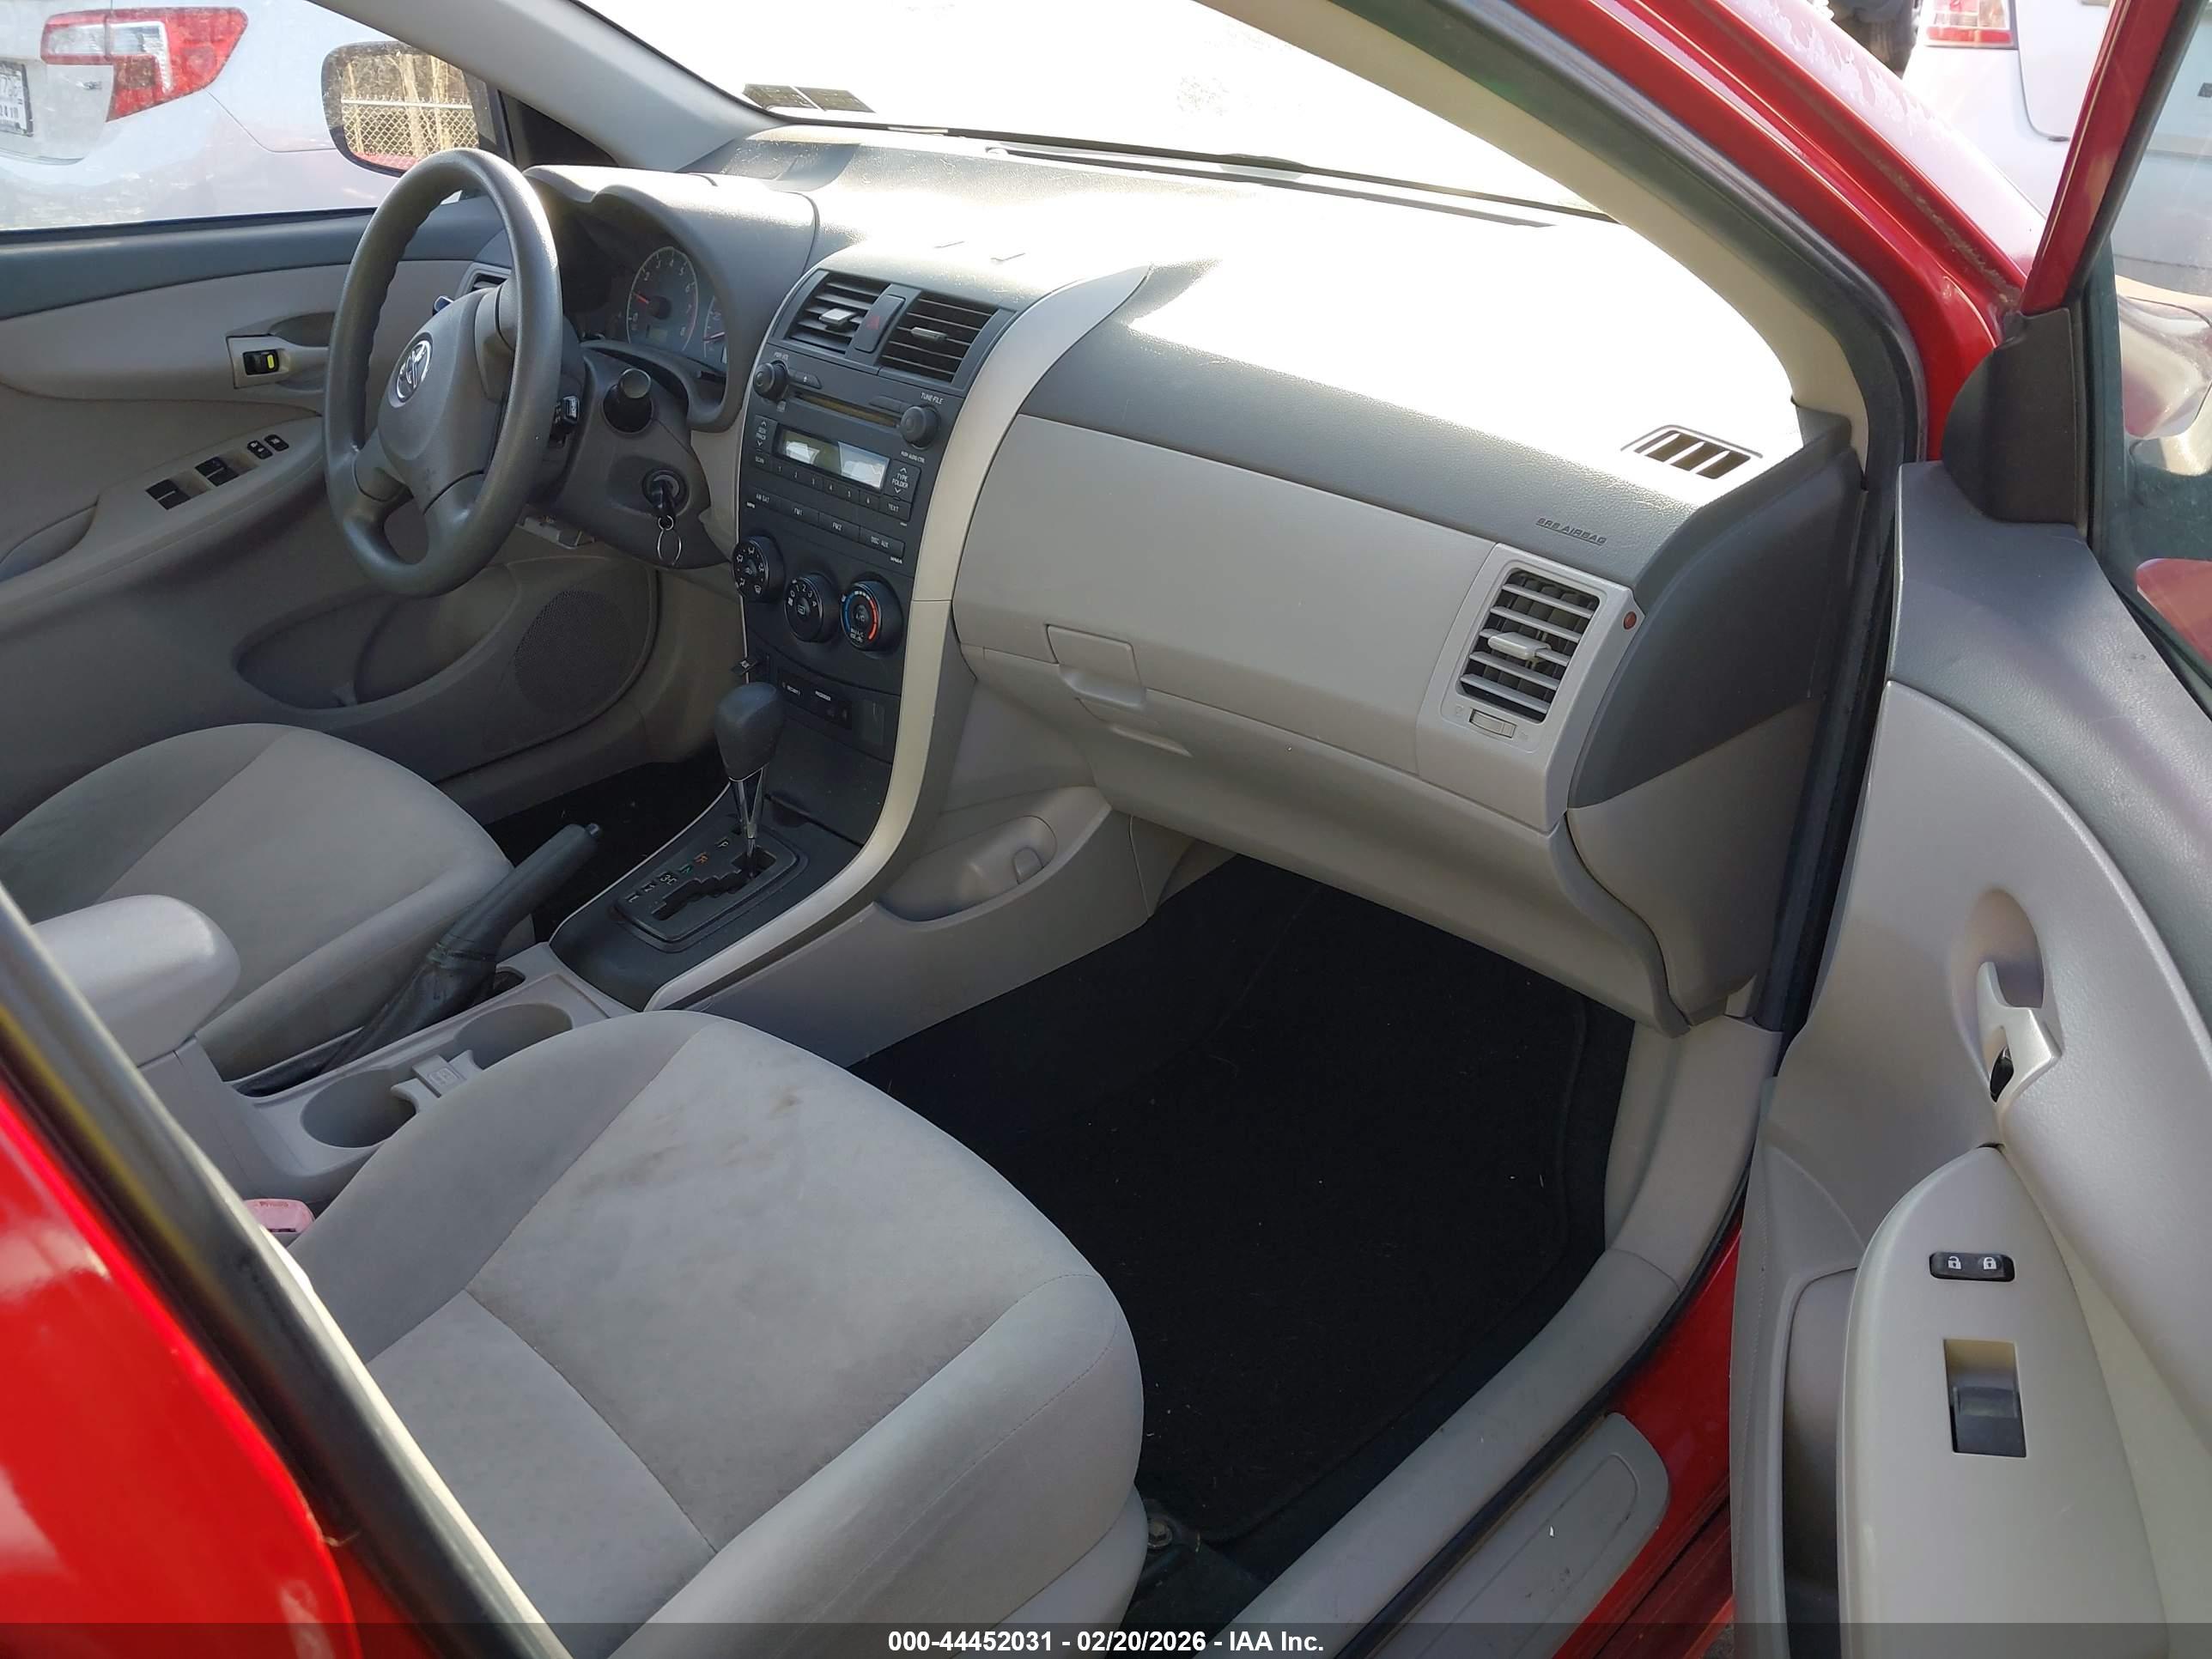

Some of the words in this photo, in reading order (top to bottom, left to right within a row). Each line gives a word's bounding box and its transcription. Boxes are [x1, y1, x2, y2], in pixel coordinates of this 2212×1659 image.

[896, 473, 908, 482] TYPE
[892, 478, 908, 489] FOLDER
[888, 503, 899, 513] TEXT
[832, 521, 842, 532] FM2
[1562, 526, 1607, 544] AIRBAG
[802, 584, 806, 592] 2
[807, 590, 813, 599] 3
